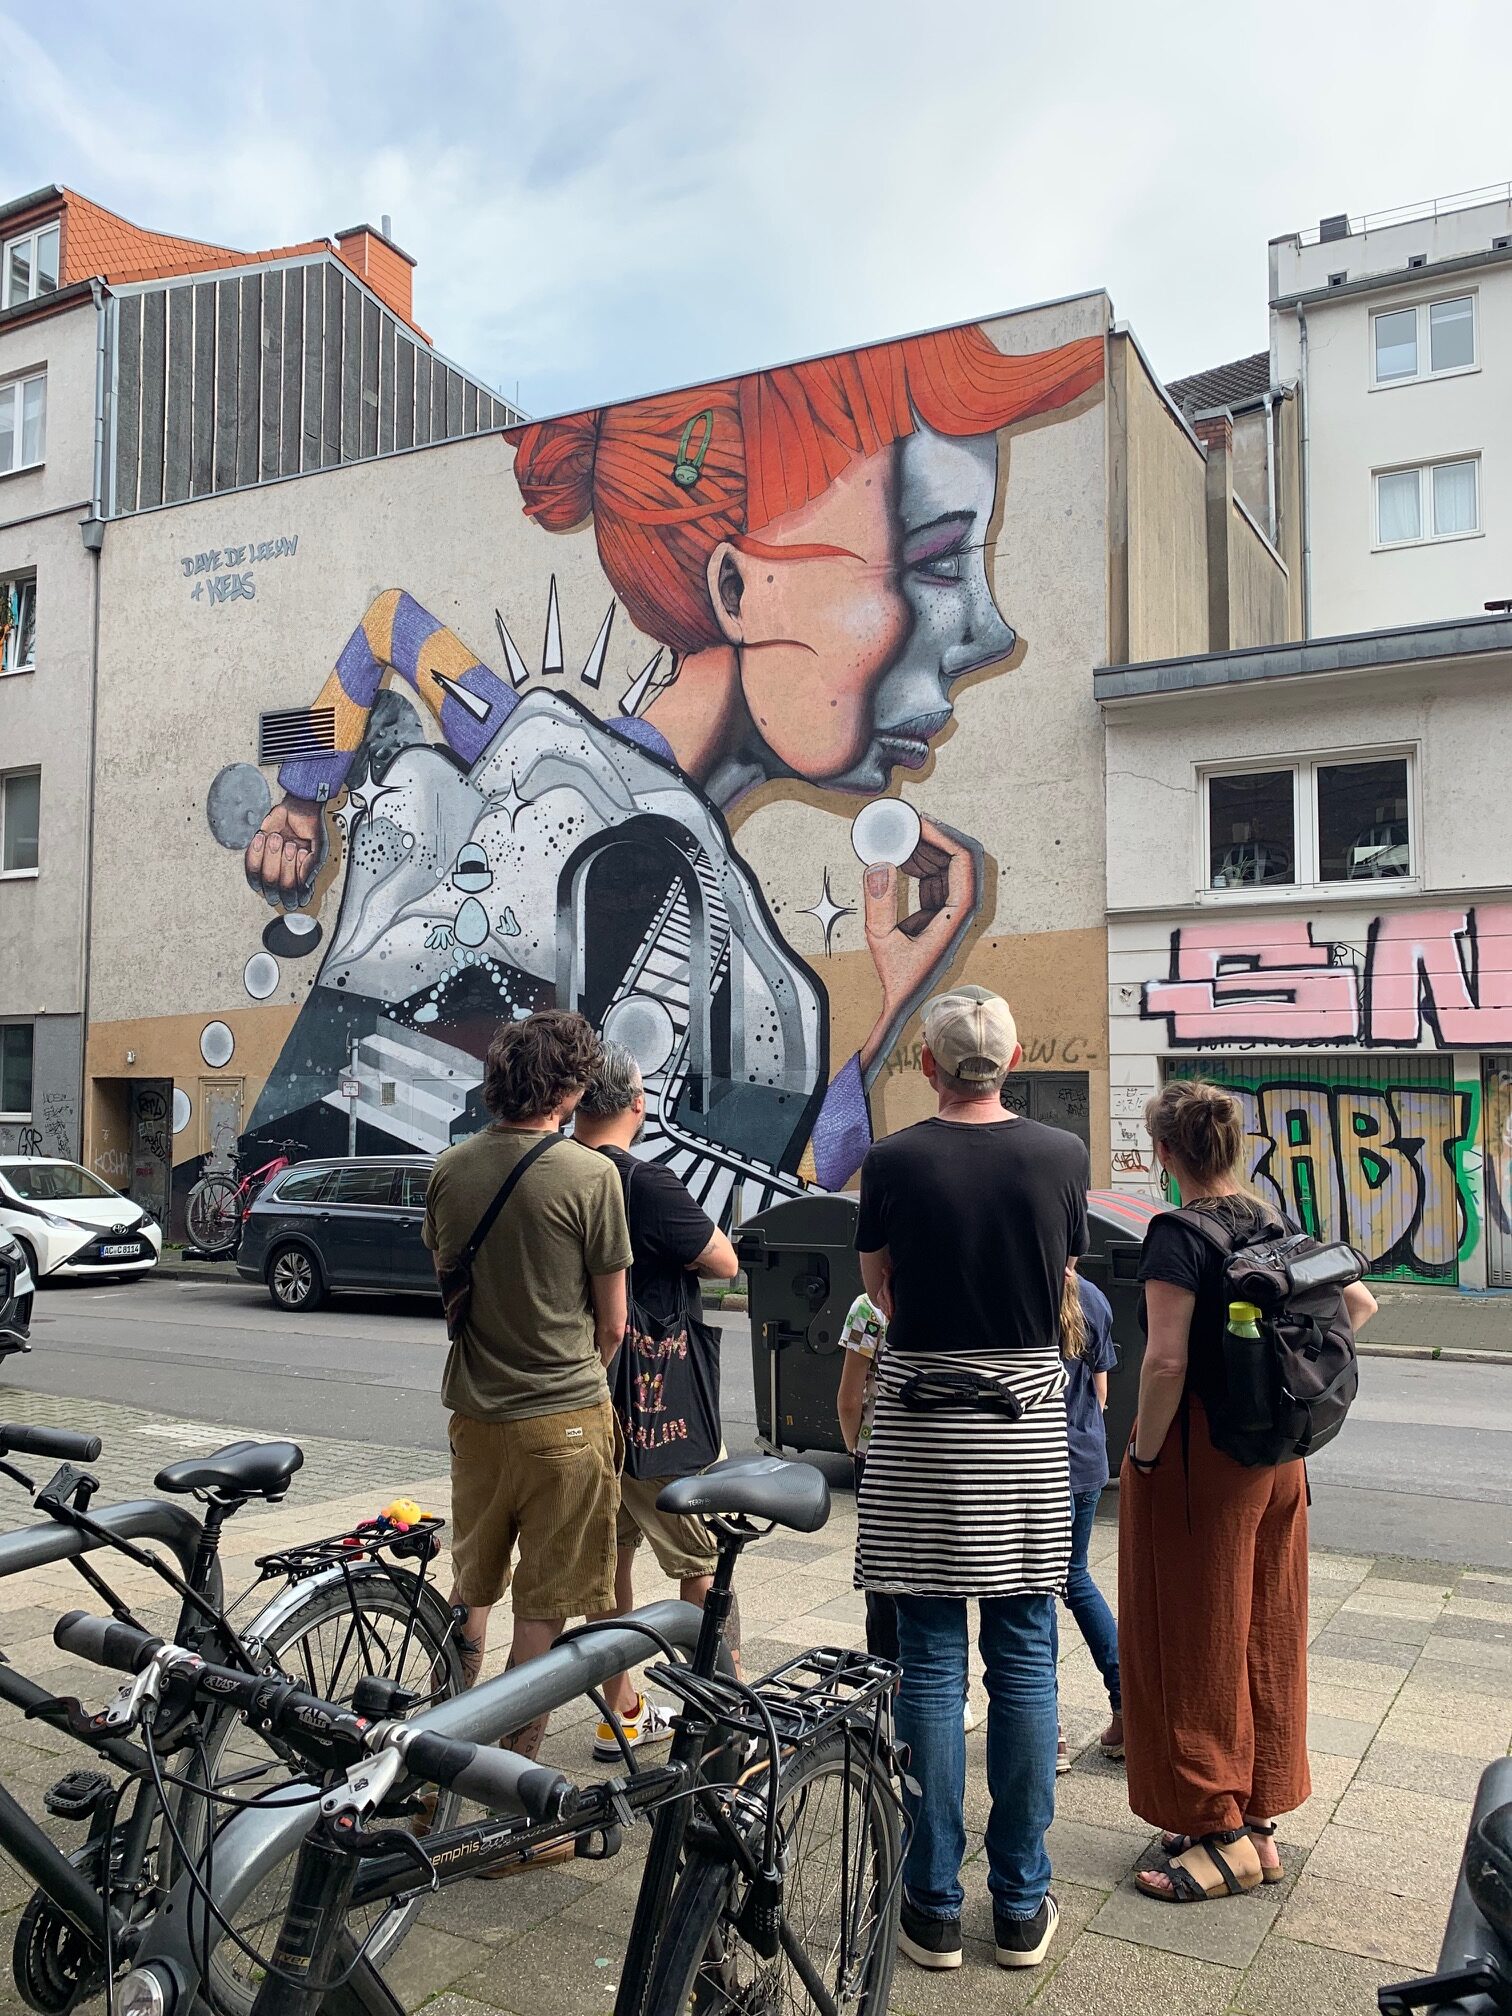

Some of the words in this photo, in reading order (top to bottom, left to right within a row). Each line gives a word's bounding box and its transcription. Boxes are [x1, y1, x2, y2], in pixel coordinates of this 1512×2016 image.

[181, 549, 223, 577] DAVE
[224, 546, 246, 567] DE
[249, 535, 298, 563] LEEUW
[206, 571, 256, 607] KEAS
[104, 1246, 114, 1255] AC
[429, 1840, 480, 1866] emphis
